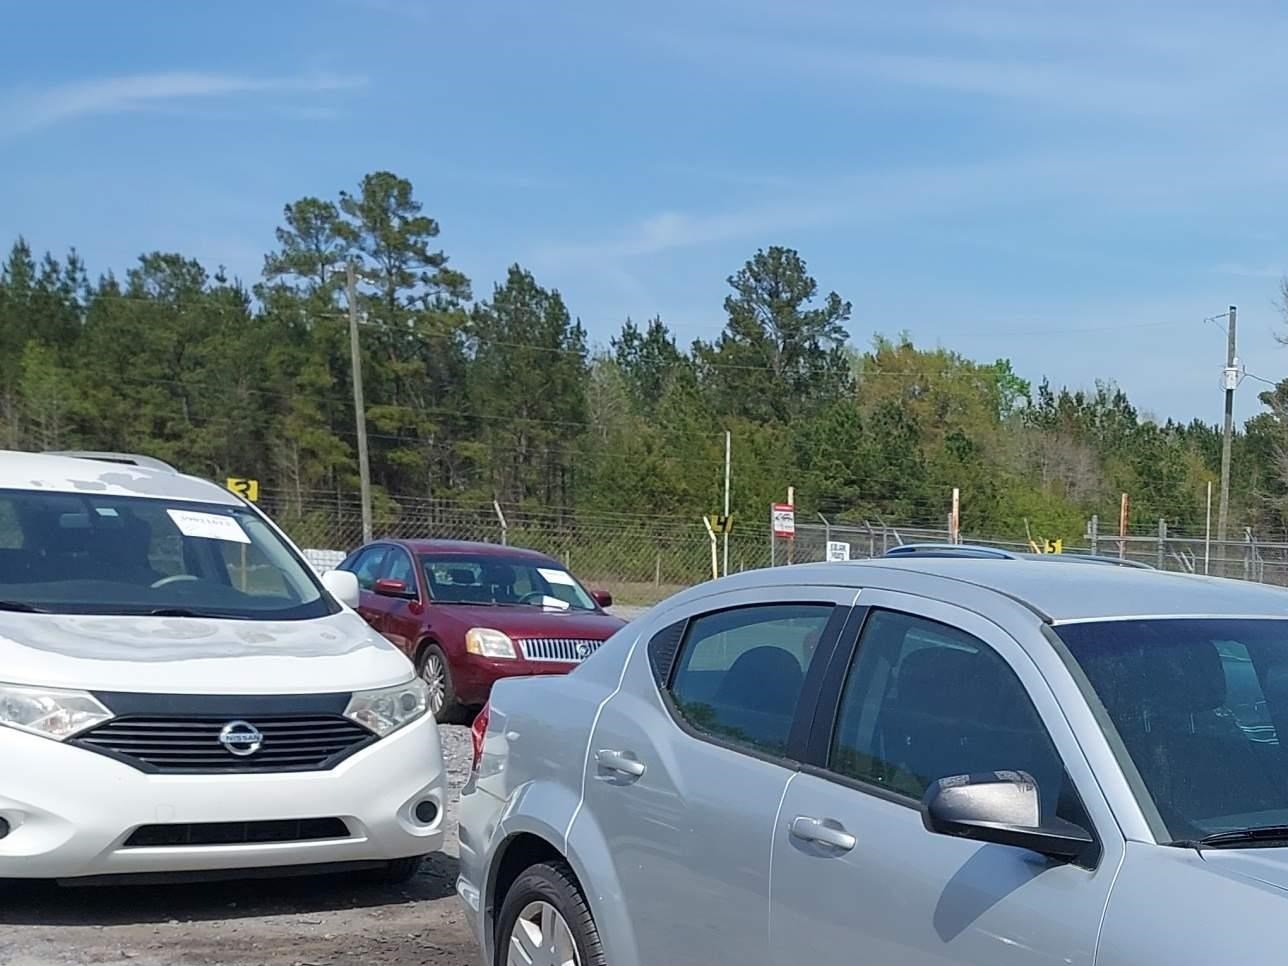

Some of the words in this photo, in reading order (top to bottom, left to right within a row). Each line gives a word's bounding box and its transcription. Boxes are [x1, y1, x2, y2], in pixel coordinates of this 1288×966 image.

[716, 514, 732, 533] 4
[1047, 539, 1057, 553] 5
[224, 733, 260, 742] NISSAN
